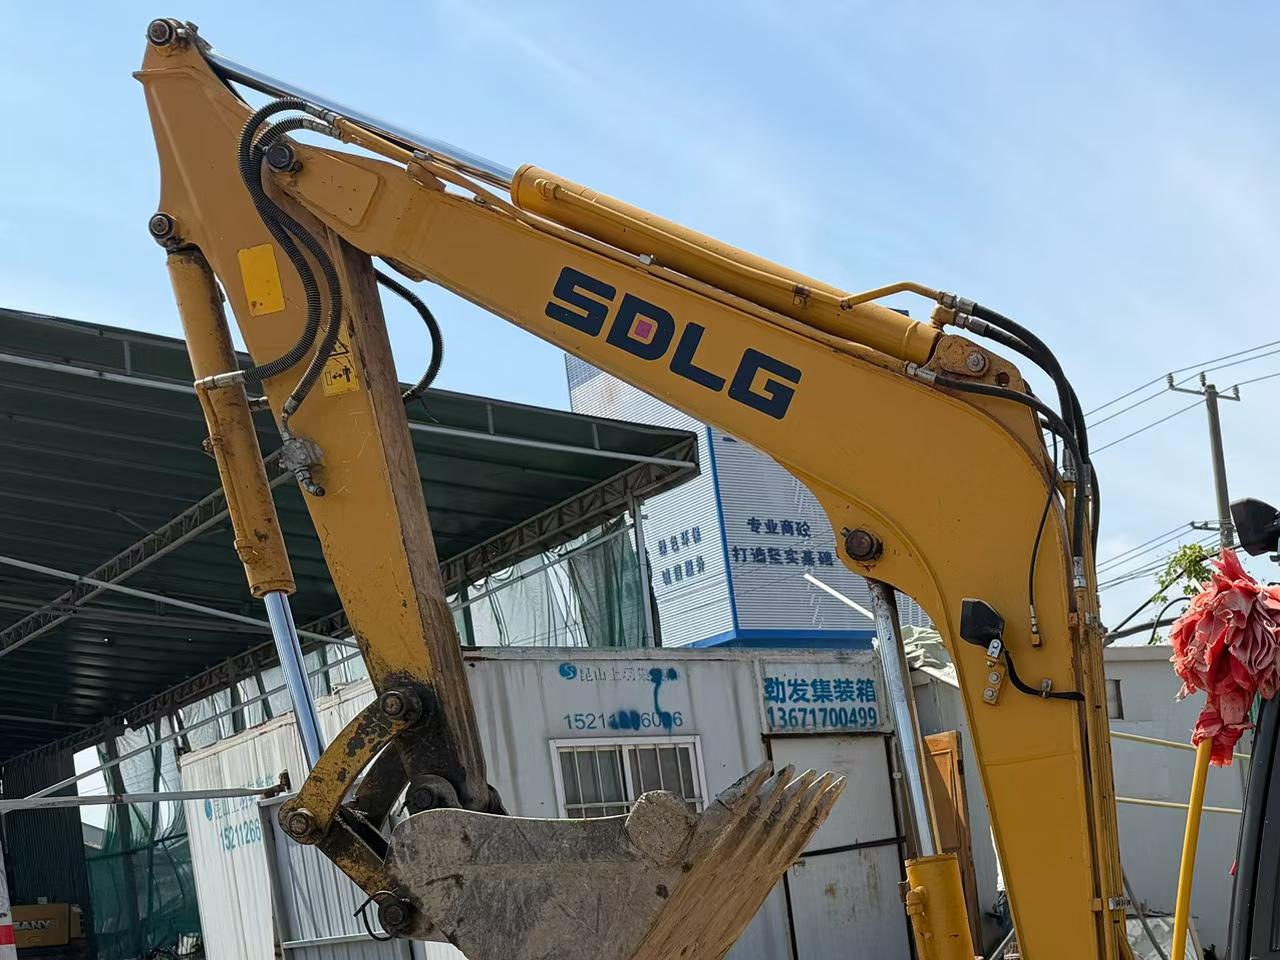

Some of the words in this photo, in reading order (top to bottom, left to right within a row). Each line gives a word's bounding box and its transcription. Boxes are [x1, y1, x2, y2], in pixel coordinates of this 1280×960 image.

[544, 266, 803, 420] SDLG
[764, 677, 877, 703] 劲发集装箱
[767, 706, 878, 729] 13671700499
